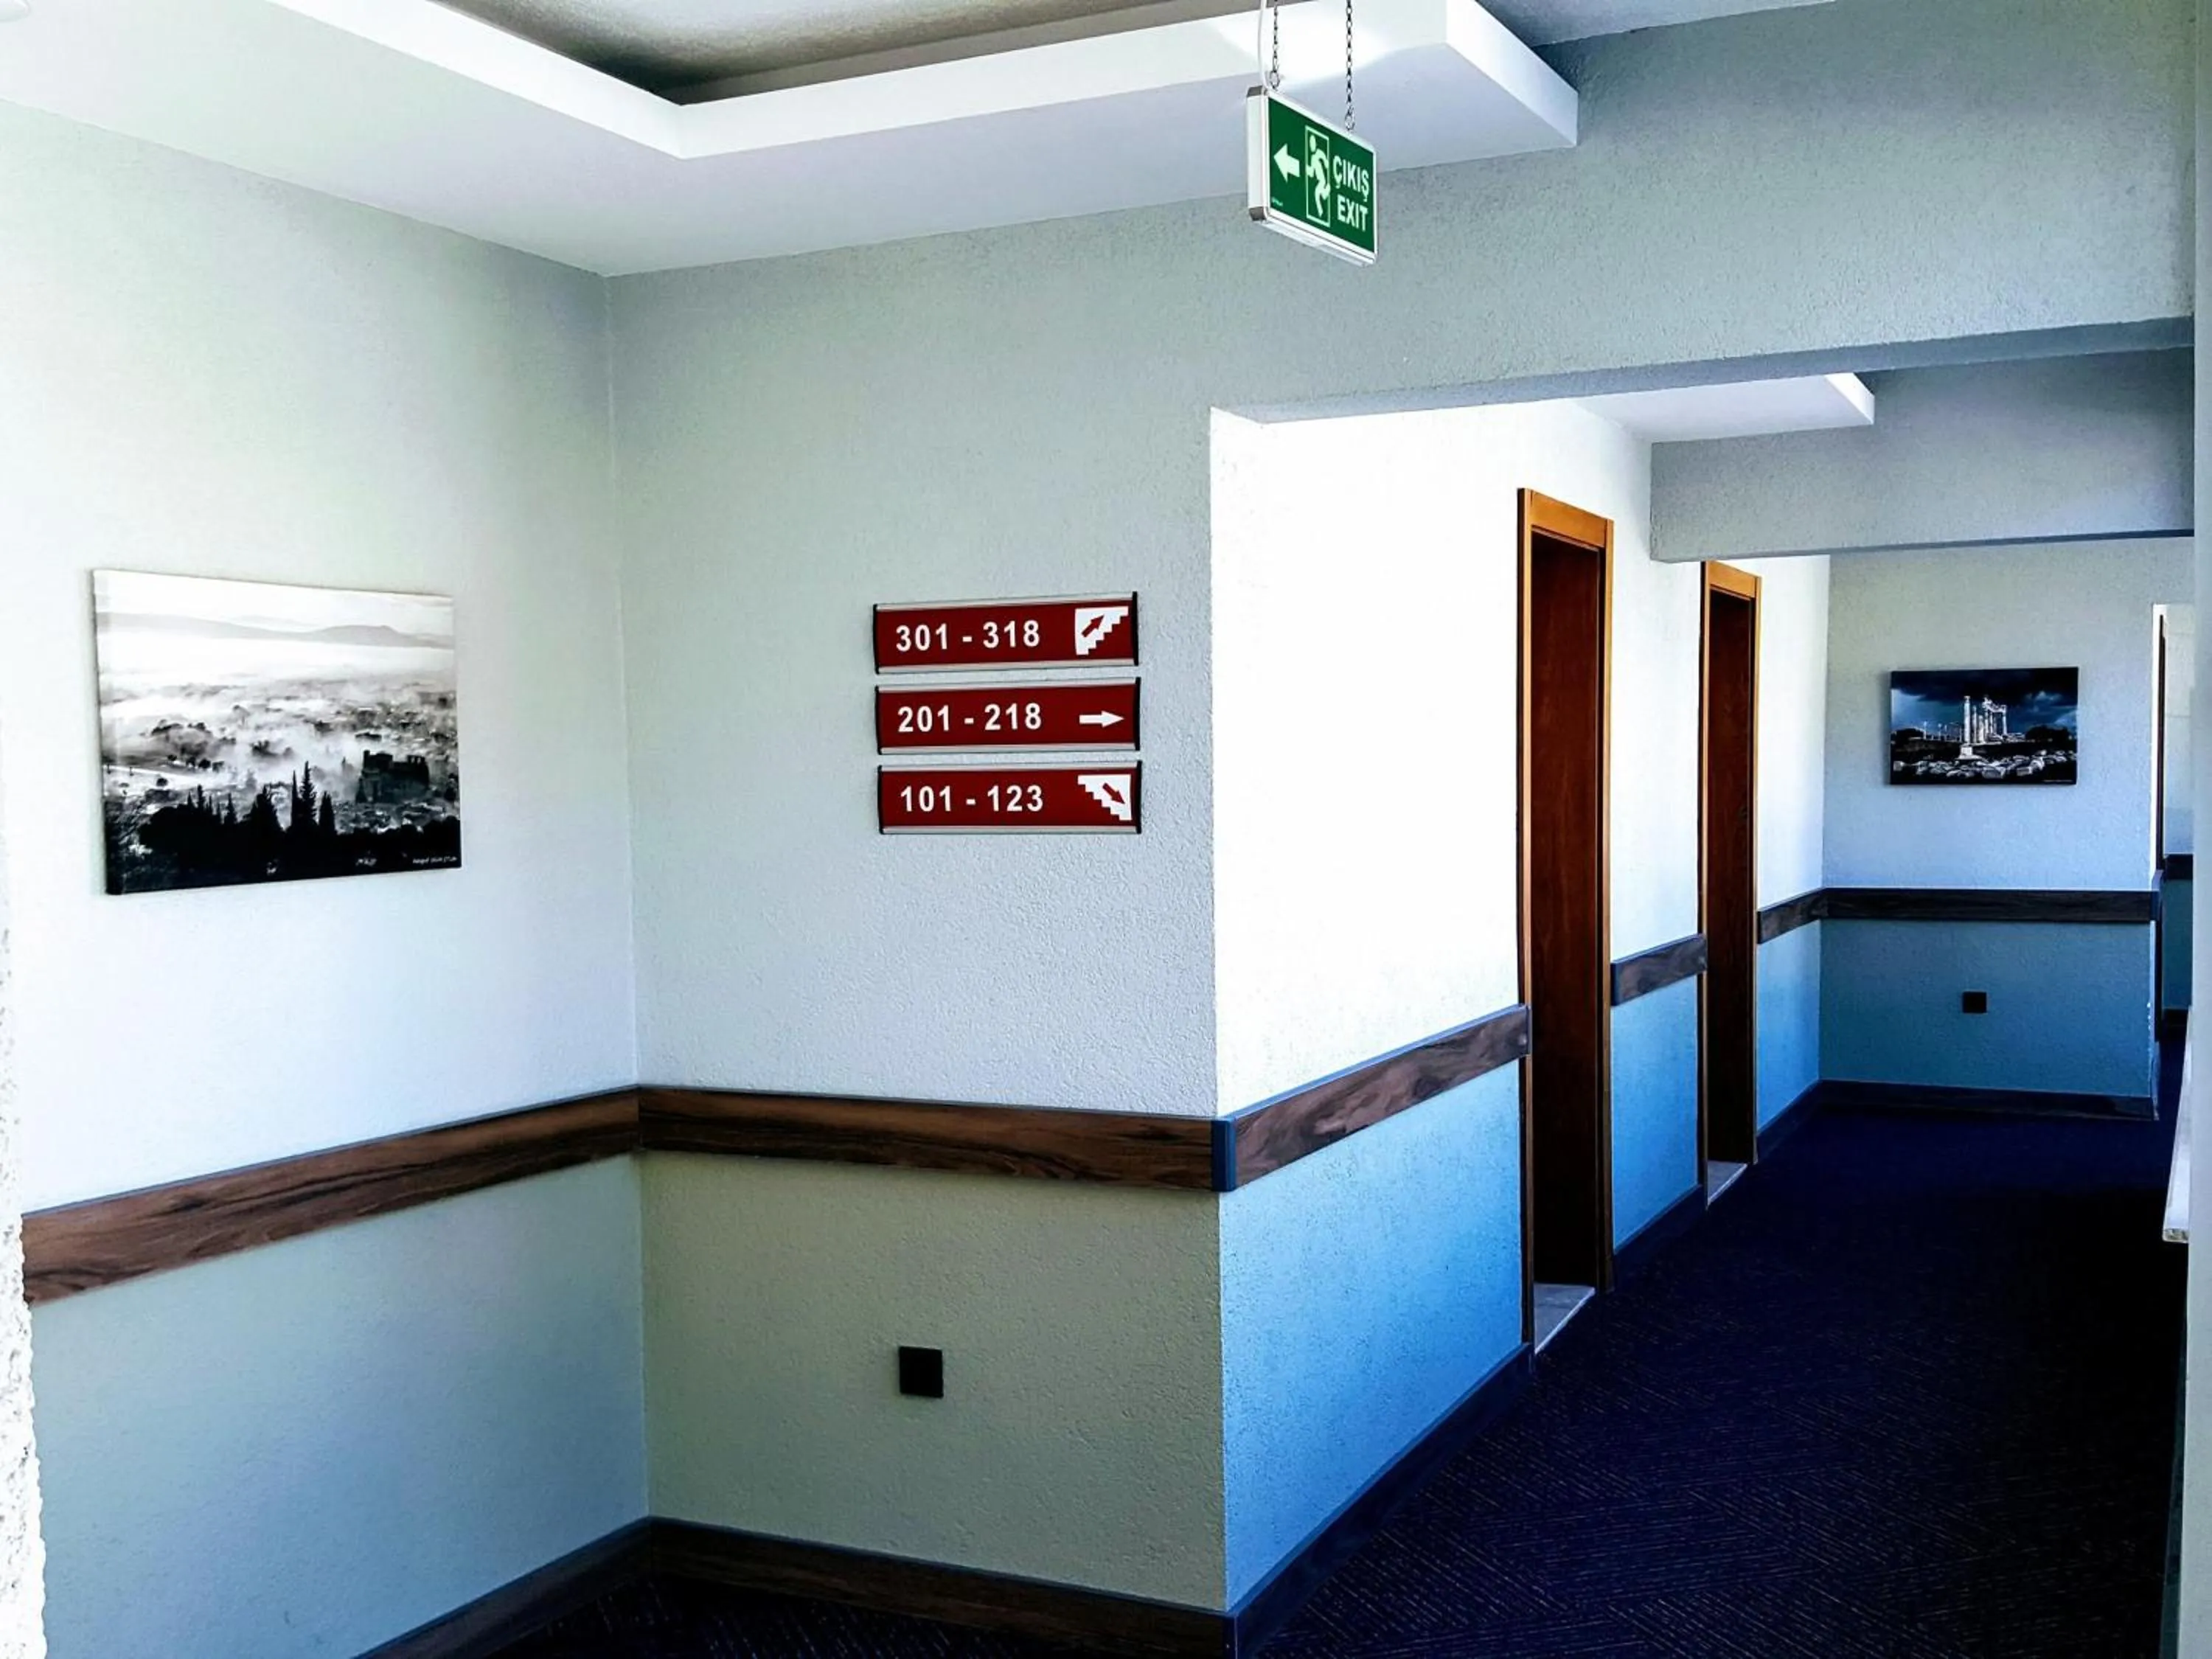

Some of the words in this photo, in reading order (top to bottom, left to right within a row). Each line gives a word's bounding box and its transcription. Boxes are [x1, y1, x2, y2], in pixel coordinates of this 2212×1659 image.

[1332, 155, 1369, 203] ÇIKIŞ
[1337, 194, 1368, 232] EXIT
[895, 623, 948, 652] 301
[982, 619, 1040, 648] 318
[897, 705, 950, 732] 201
[984, 703, 1042, 731] 218
[900, 785, 951, 812] 101
[987, 785, 1043, 812] 123
